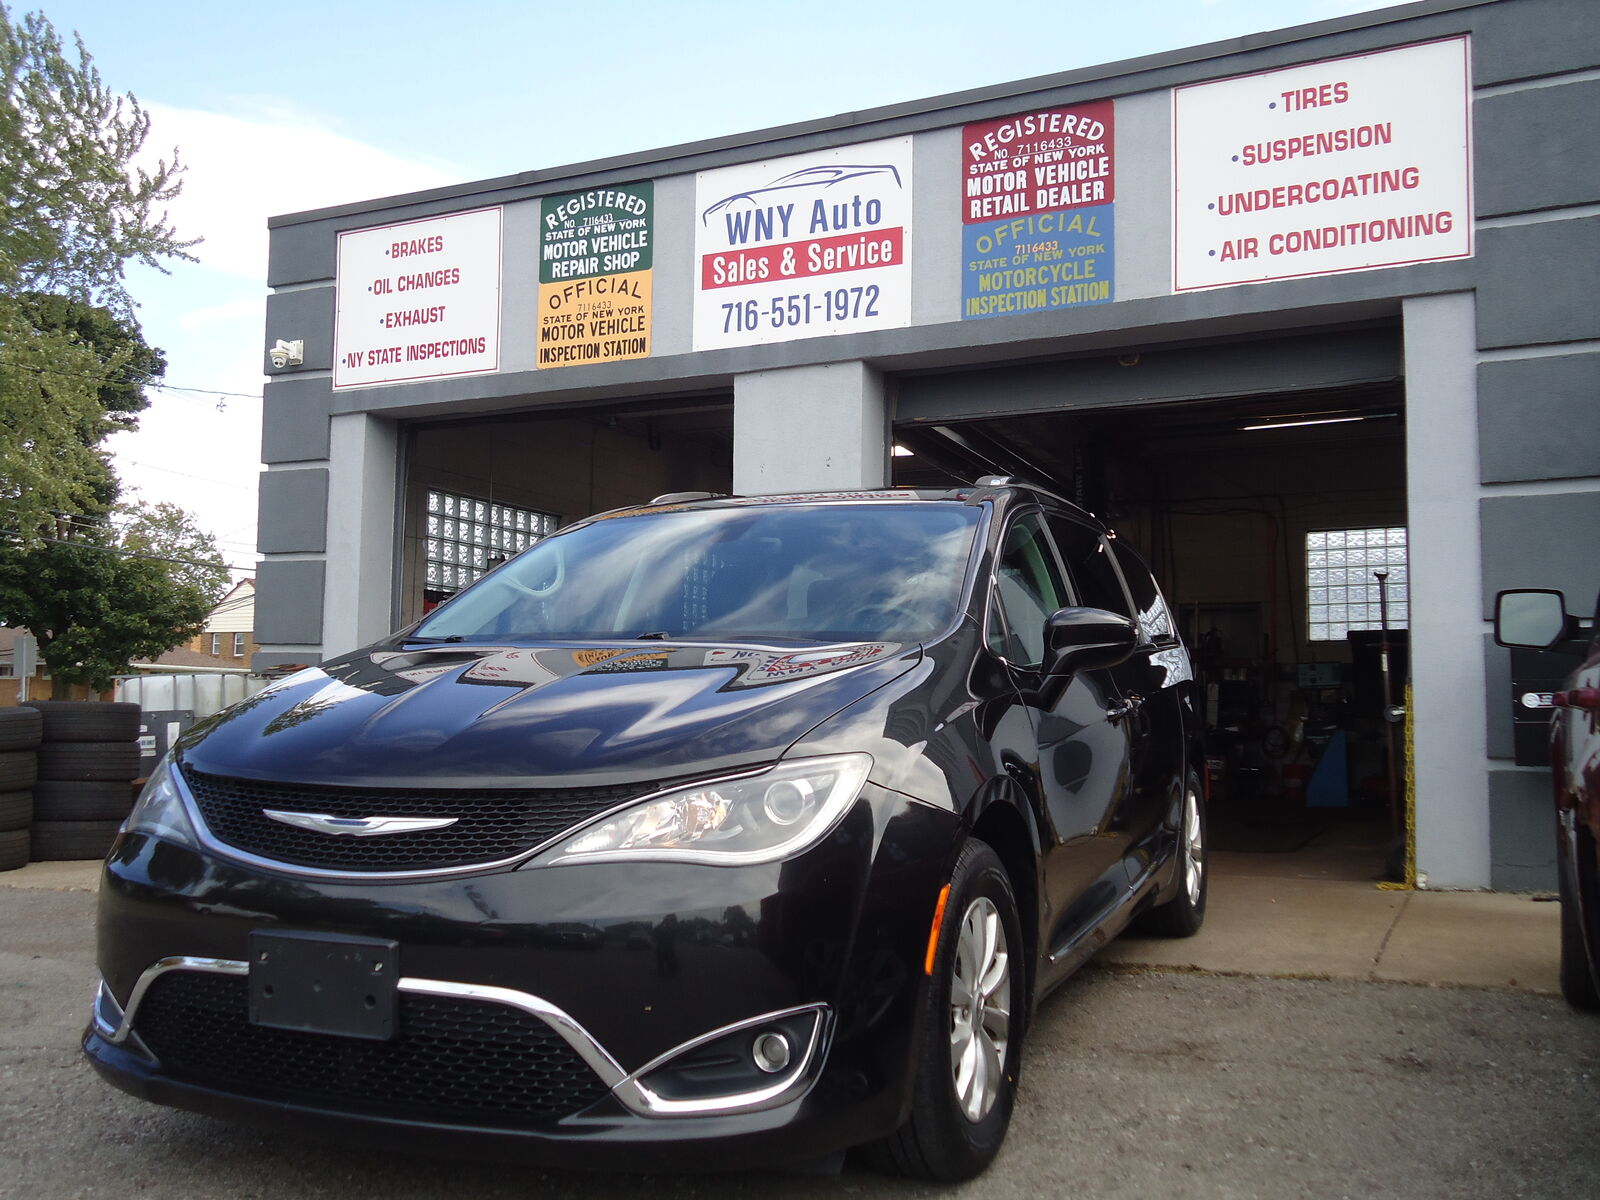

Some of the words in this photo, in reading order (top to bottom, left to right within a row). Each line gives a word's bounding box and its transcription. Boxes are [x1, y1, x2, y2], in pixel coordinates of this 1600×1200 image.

[1282, 82, 1348, 112] TIRES
[969, 114, 1104, 161] REGISTERED
[1018, 137, 1072, 155] 7116433
[1242, 122, 1392, 166] SUSPENSION
[970, 160, 1007, 175] STATE
[1013, 156, 1029, 168] OF
[1035, 150, 1063, 165] NEW
[1068, 144, 1105, 158] YORK
[967, 170, 1027, 197] MOTOR
[1035, 157, 1109, 187] VEHICLE
[1218, 166, 1419, 216] UNDERCOATING
[546, 191, 646, 229] REGISTERED
[971, 193, 1030, 218] RETAIL
[1036, 181, 1104, 209] DEALER
[546, 229, 574, 241] STATE
[578, 227, 590, 236] OF
[594, 222, 616, 234] NEW
[620, 218, 646, 230] YORK
[583, 214, 613, 226] 7116433
[726, 204, 794, 245] WNY
[810, 195, 881, 233] Auto
[976, 214, 1101, 253] OFFICIAL
[392, 236, 443, 258] BRAKES
[544, 240, 588, 260] MOTOR
[592, 231, 648, 254] VEHICLE
[1016, 241, 1058, 255] 7116433
[1220, 237, 1258, 262] AIR
[1269, 211, 1452, 256] CONDITIONING
[552, 257, 598, 278] REPAIR
[604, 252, 640, 271] SHOP
[713, 254, 769, 284] Sales
[780, 247, 796, 275] &
[808, 237, 892, 272] Service
[969, 257, 1007, 271] STATE
[1013, 254, 1029, 265] OF
[1034, 250, 1063, 262] NEW
[1069, 243, 1105, 257] YORK
[374, 278, 392, 295] OIL
[398, 268, 459, 291] CHANGES
[979, 259, 1095, 292] MOTORCYCLE
[549, 278, 641, 309] OFFICIAL
[578, 301, 611, 311] 7116433
[722, 285, 879, 333] 716-551-1972
[966, 289, 1046, 316] INSPECTION
[1051, 281, 1109, 305] STATION
[386, 306, 445, 328] EXHAUST
[542, 323, 584, 342] MOTOR
[590, 316, 645, 337] VEHICLE
[544, 315, 572, 324] STATE
[576, 312, 588, 321] OF
[592, 309, 613, 319] NEW
[618, 306, 644, 316] YORK
[347, 352, 363, 368] NY
[368, 347, 401, 365] STATE
[407, 337, 485, 361] INSPECTIONS
[540, 343, 600, 363] INSPECTION
[604, 338, 646, 356] STATION
